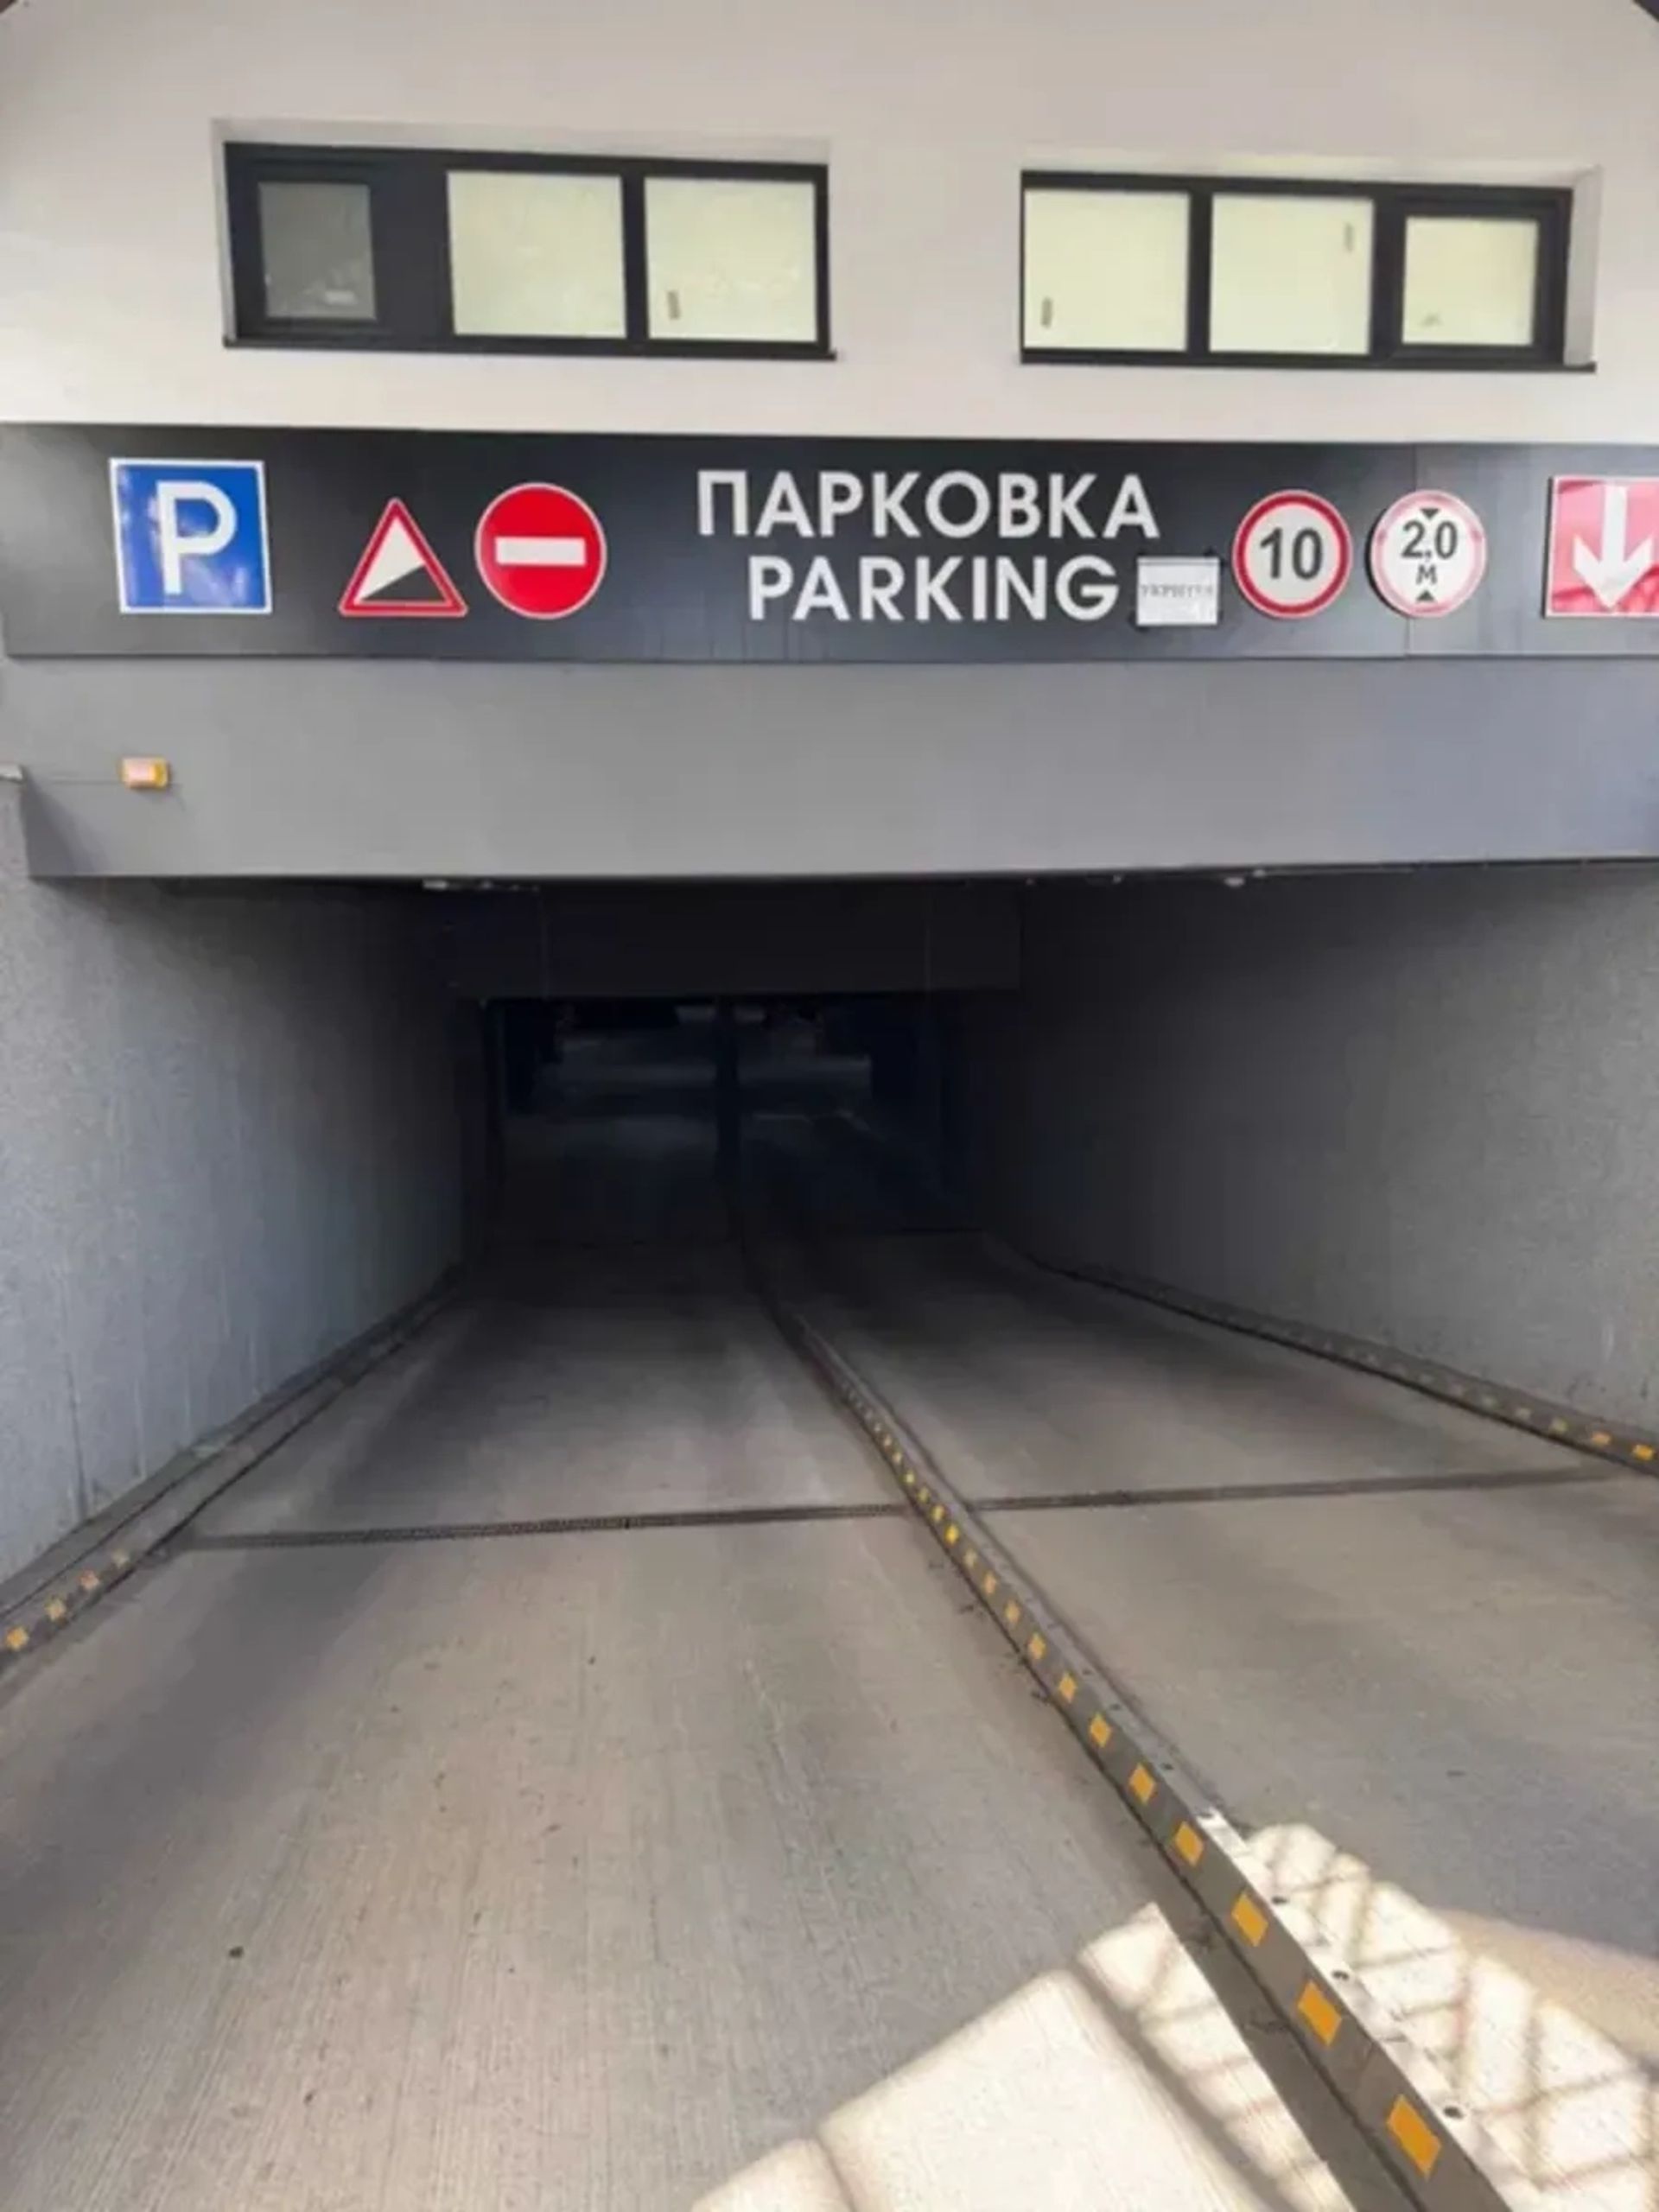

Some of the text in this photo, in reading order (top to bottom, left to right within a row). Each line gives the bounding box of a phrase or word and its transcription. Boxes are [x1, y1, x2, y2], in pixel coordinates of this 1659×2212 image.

[696, 470, 1160, 538] ПАРКОВКА
[157, 481, 238, 594] P
[1255, 526, 1324, 580] 10
[747, 556, 1121, 621] PARKING
